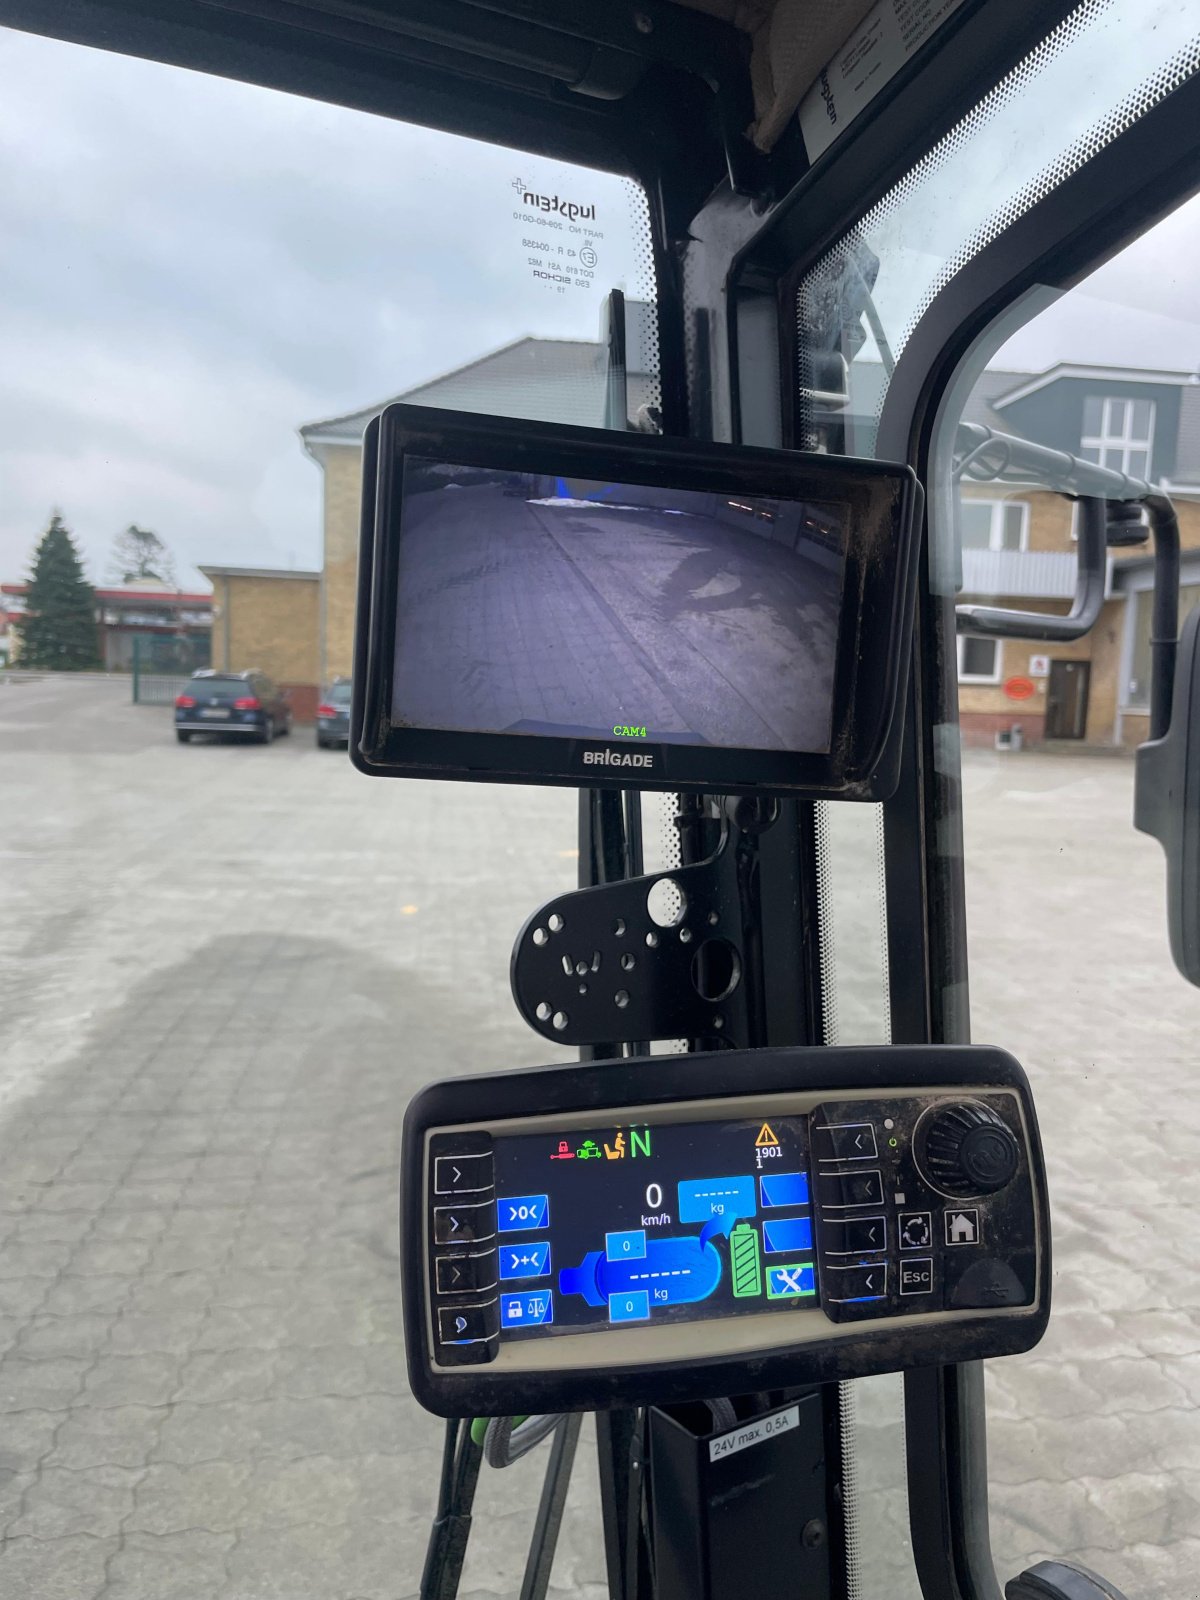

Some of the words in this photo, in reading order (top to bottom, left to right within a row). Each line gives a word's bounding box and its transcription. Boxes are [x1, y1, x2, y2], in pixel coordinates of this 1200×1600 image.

[905, 9, 942, 52] PRODUCTION
[613, 725, 648, 738] CAM4
[583, 748, 654, 768] BRIGADE
[630, 1130, 652, 1158] N
[755, 1146, 783, 1159] 1901
[645, 1183, 663, 1208] 0
[710, 1203, 725, 1215] kg
[640, 1212, 671, 1226] km/h
[622, 1240, 631, 1252] 0
[654, 1287, 669, 1301] kg
[625, 1300, 634, 1312] 0
[714, 1437, 736, 1456] 24V
[738, 1428, 763, 1445] max.
[765, 1415, 790, 1434] 0,5A
